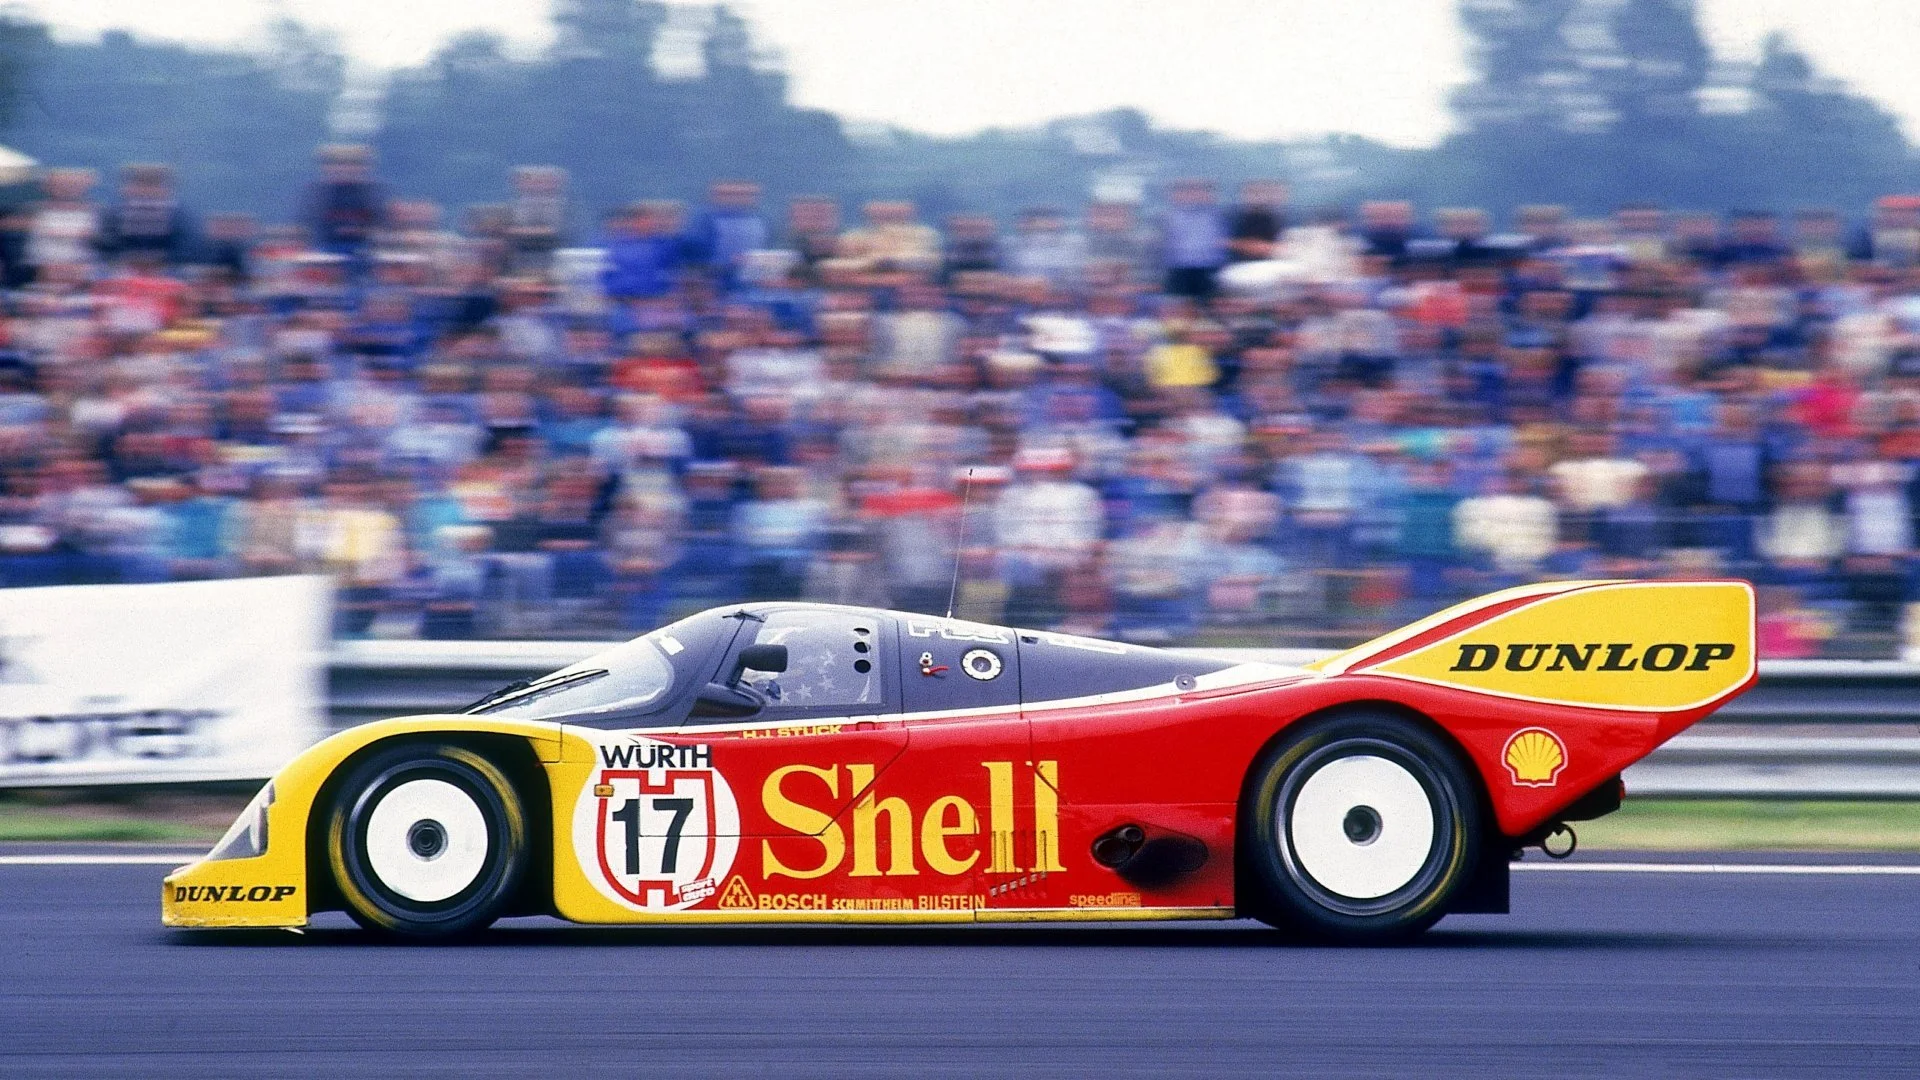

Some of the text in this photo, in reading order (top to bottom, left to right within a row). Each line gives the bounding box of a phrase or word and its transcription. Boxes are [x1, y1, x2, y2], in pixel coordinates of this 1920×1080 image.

[1450, 643, 1735, 671] DUNLOP
[777, 725, 842, 738] STUCK
[600, 744, 712, 768] WÜRTH
[761, 760, 1067, 880] Shell
[612, 798, 694, 874] 17
[175, 886, 296, 902] DUNLOP
[758, 894, 827, 910] BOSCH
[918, 894, 986, 910] BILSTEIN
